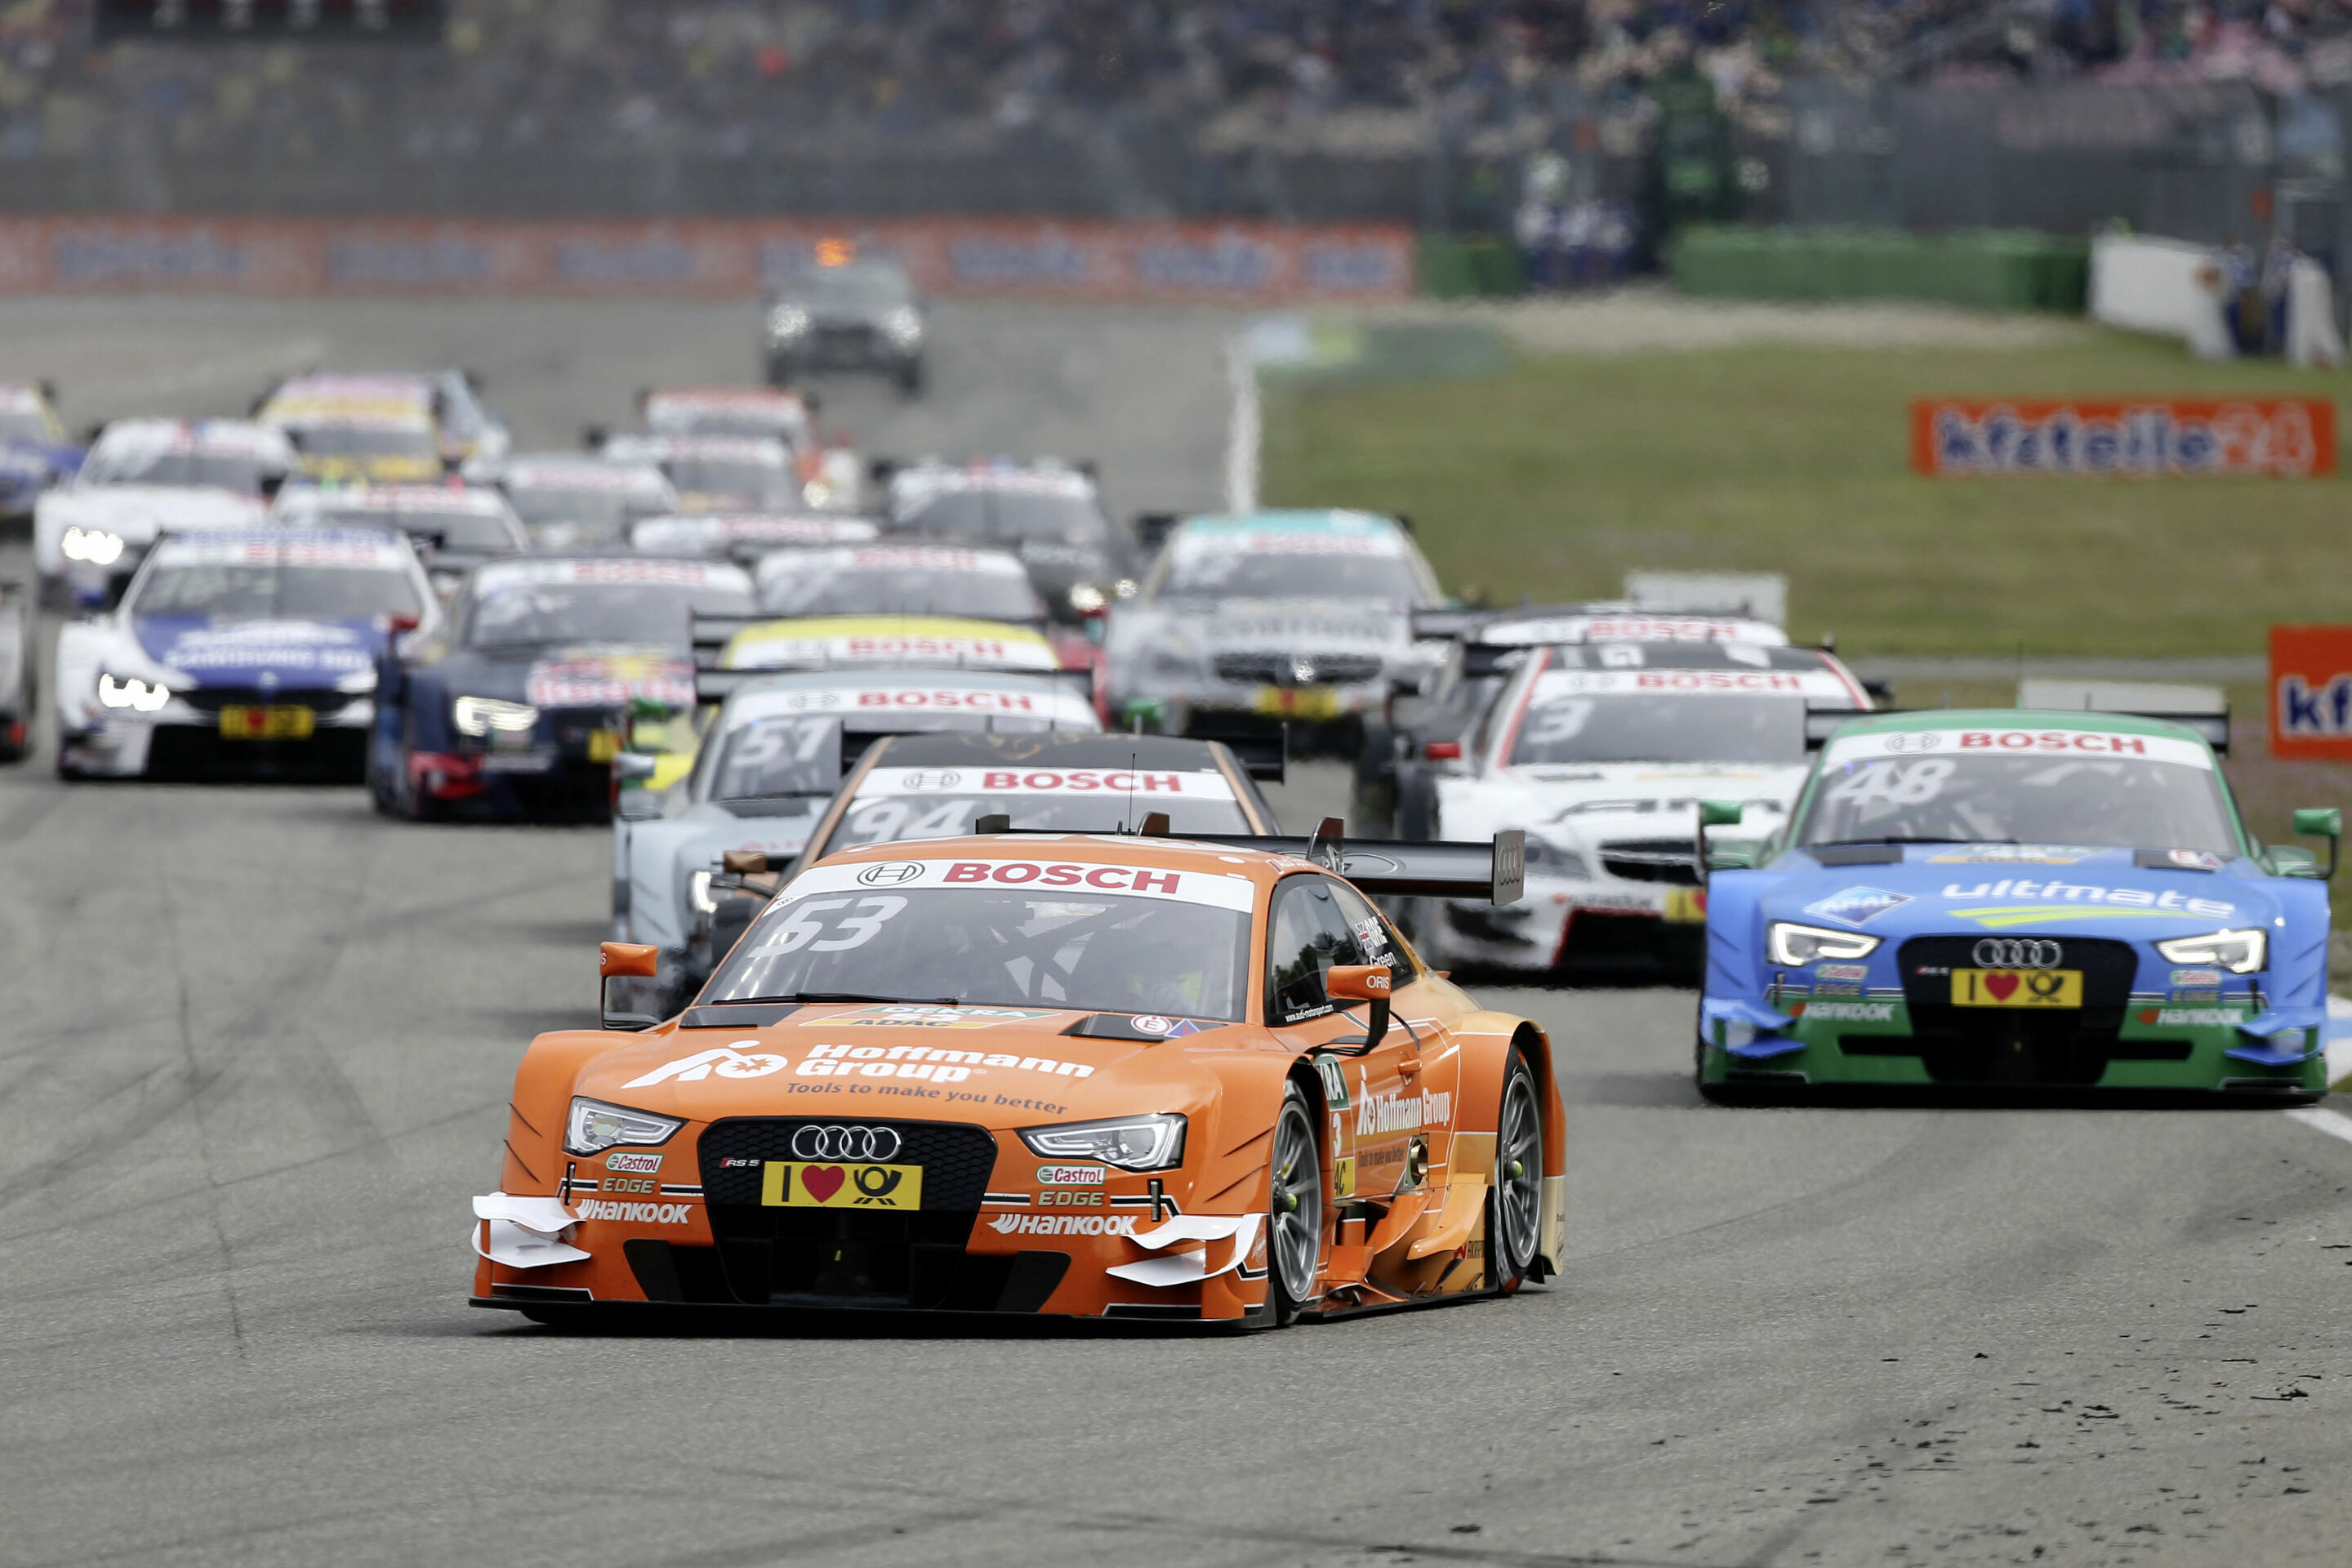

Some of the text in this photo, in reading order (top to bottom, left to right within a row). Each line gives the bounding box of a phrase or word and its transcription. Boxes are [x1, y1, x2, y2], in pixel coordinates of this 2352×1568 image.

[1588, 620, 1740, 640] BOSCH
[848, 639, 1004, 658] BOSCH
[1637, 671, 1802, 691] BOSCH
[858, 692, 1033, 711] BOSCH
[1526, 700, 1594, 743] 3
[1960, 732, 2146, 755] BOSCH
[982, 771, 1182, 793] BOSCH
[1825, 759, 1956, 806] 48
[846, 799, 977, 846] 94
[942, 862, 1181, 894] BOSCH
[1941, 879, 2236, 919] ultimate
[746, 895, 908, 959] 53
[1366, 975, 1391, 989] ORIS
[1969, 973, 1976, 1001] I
[849, 1019, 952, 1027] ADAC
[881, 1006, 1027, 1018] DEKRA
[807, 1044, 1095, 1078] Hoffmann
[787, 1082, 1068, 1116] Tools to make you better
[1376, 1087, 1450, 1134] Hoffmann Group
[617, 1154, 660, 1172] Castrol
[602, 1177, 657, 1194] EDGE
[782, 1165, 792, 1203] I
[1054, 1167, 1102, 1184] Castrol
[1038, 1191, 1107, 1207] EDGE
